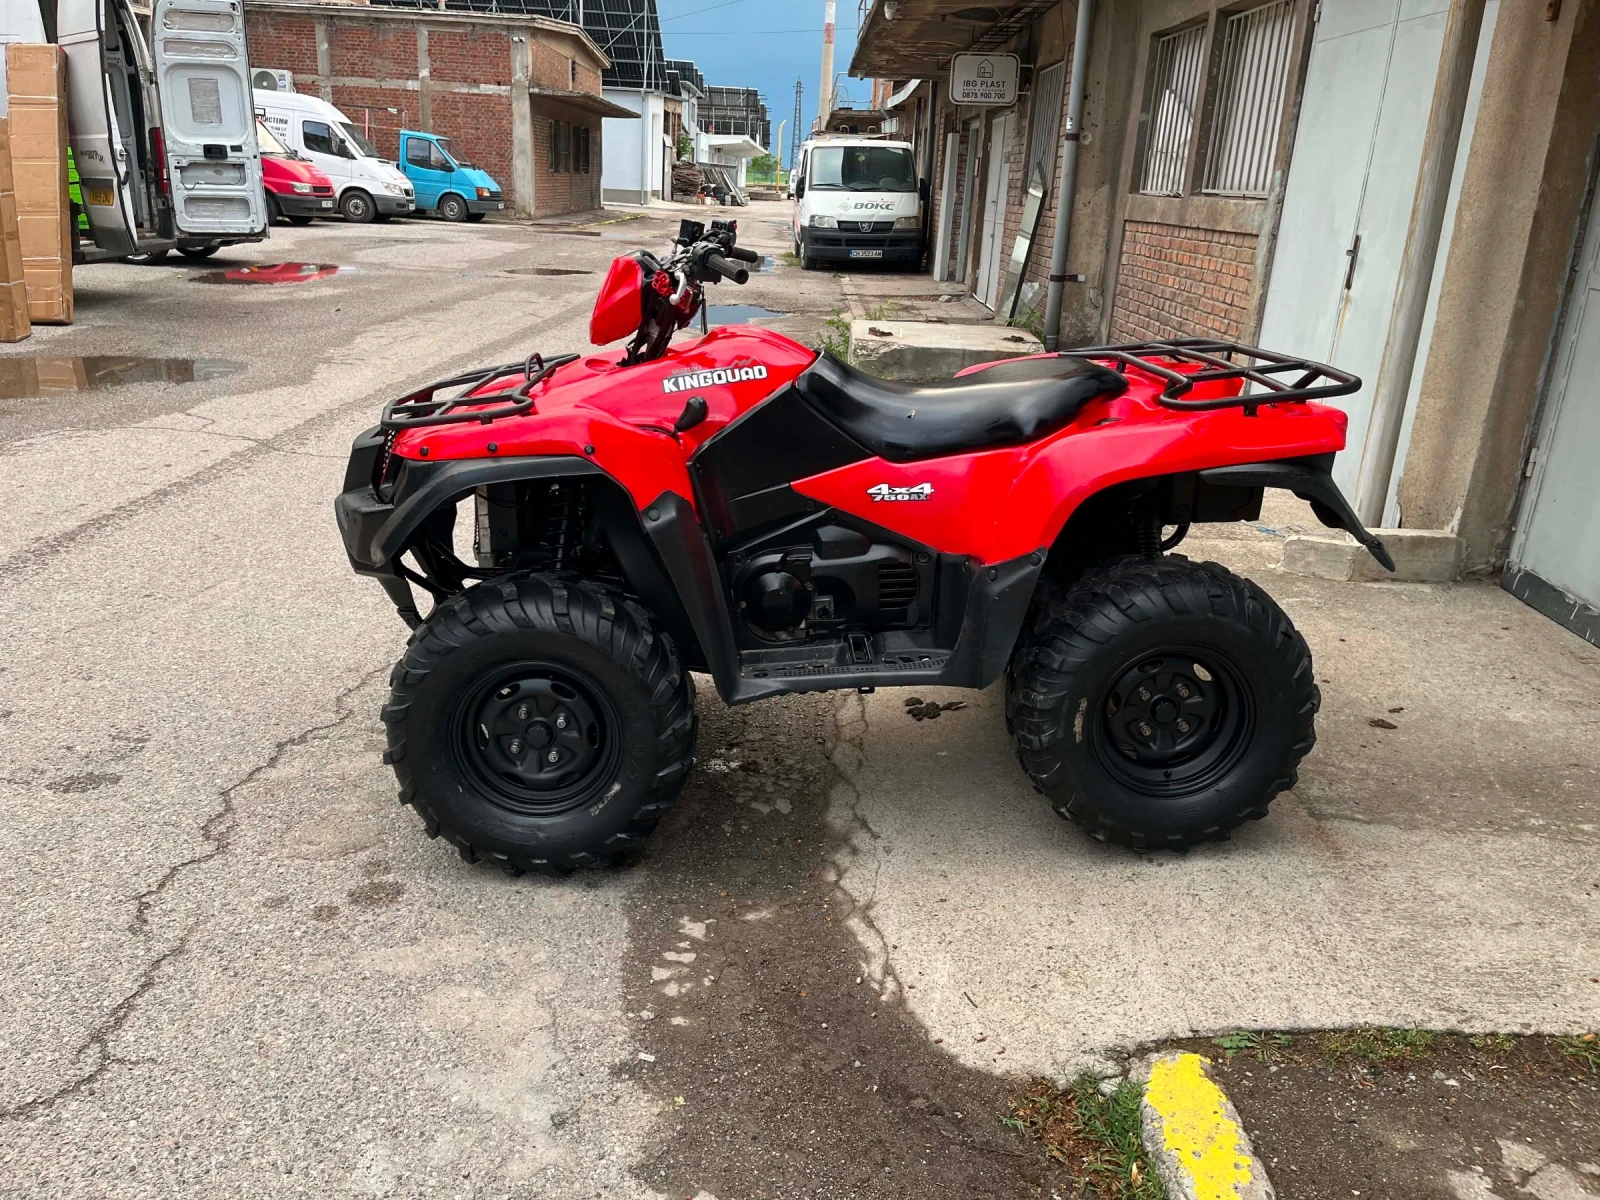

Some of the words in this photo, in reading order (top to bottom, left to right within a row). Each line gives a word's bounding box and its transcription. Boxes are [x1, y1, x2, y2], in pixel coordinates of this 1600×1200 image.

[963, 80, 978, 88] IBG
[993, 92, 1006, 100] 700
[662, 365, 768, 394] KINGQUAD
